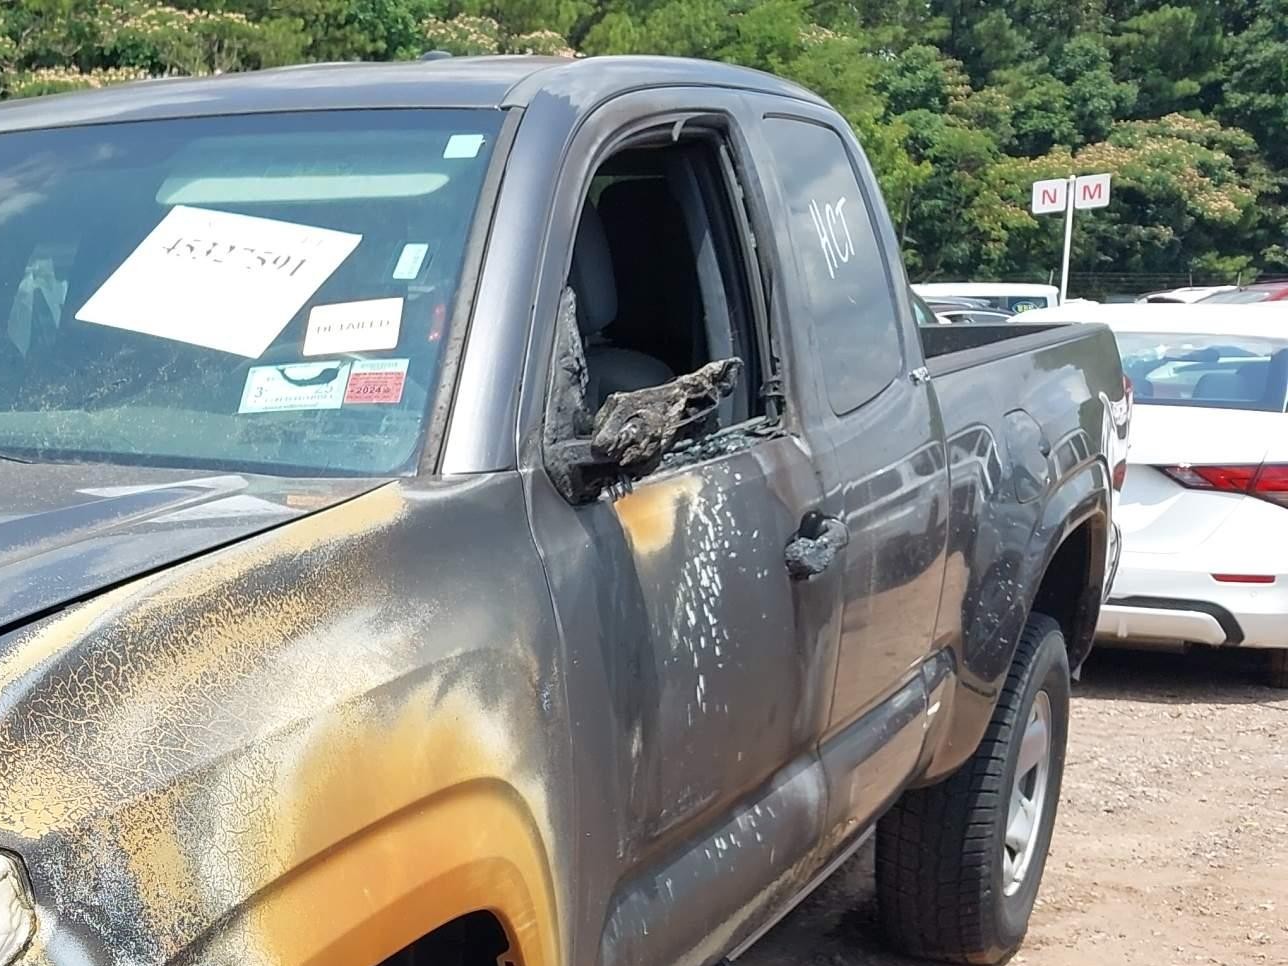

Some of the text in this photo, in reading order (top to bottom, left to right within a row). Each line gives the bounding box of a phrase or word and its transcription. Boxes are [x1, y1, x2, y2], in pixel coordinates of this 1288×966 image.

[1041, 188, 1057, 205] N
[1082, 183, 1102, 200] M
[356, 384, 382, 394] 2024
